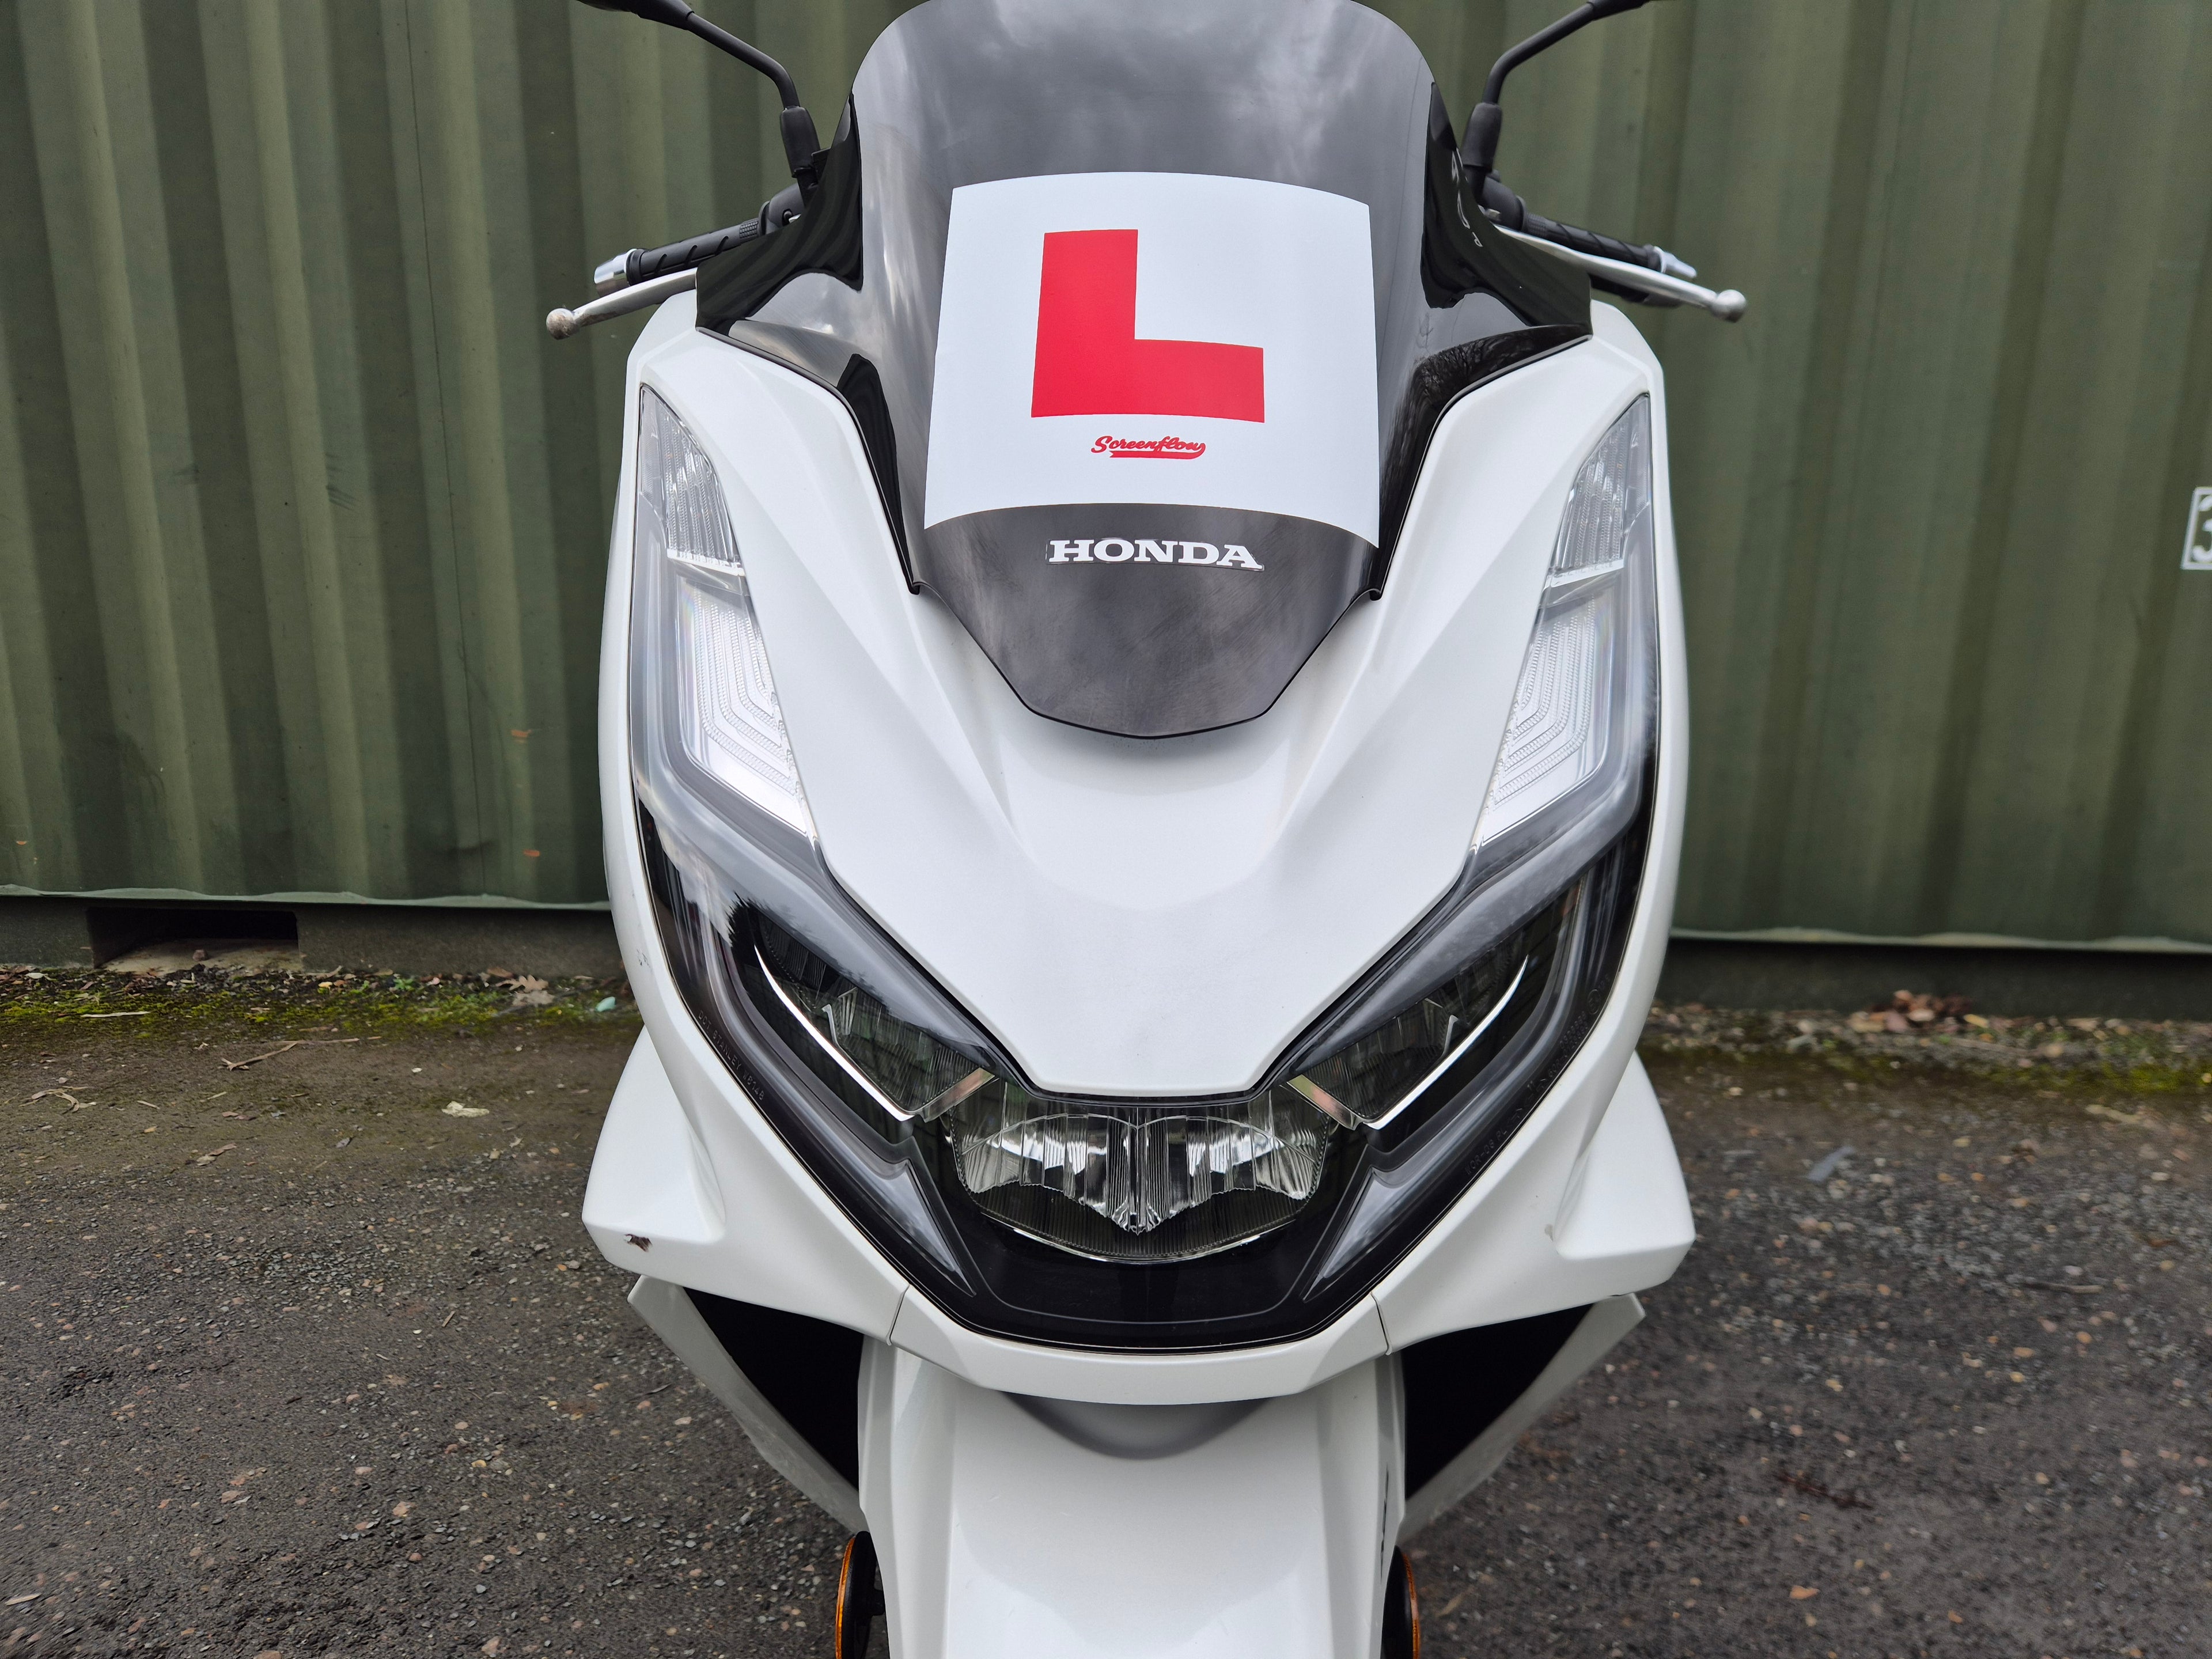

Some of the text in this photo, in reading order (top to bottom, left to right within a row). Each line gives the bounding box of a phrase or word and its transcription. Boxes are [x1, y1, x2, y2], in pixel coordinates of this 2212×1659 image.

[1031, 229, 1265, 423] L
[1091, 435, 1206, 459] Screenflow
[1048, 537, 1263, 570] HONDA
[713, 1029, 742, 1070] STANLEY
